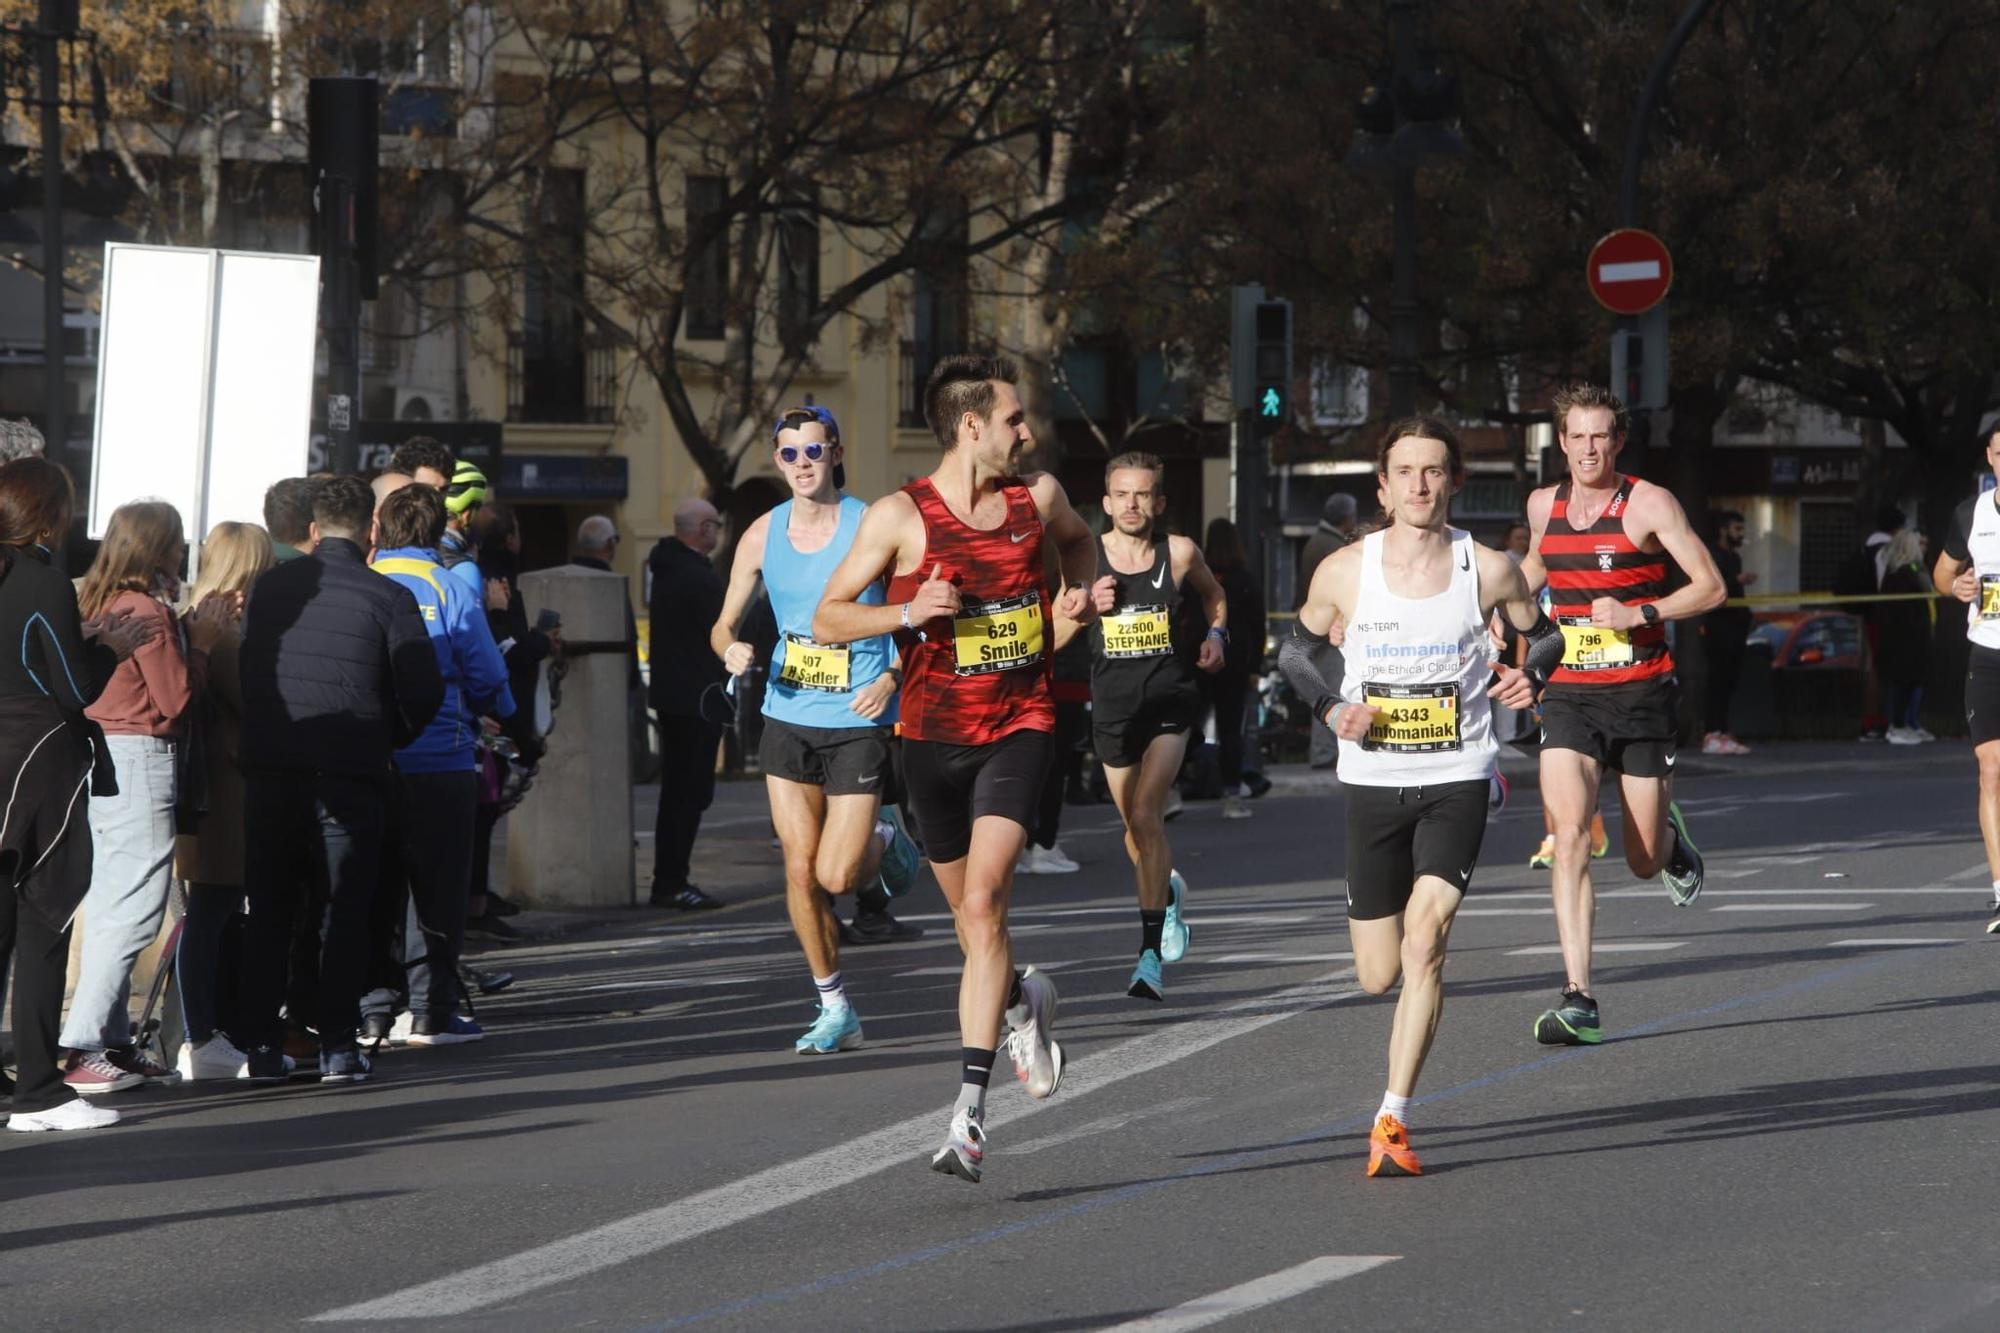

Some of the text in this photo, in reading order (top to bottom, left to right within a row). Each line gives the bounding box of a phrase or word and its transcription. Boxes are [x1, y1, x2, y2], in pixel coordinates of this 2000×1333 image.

[1608, 492, 1624, 516] soar
[988, 622, 1017, 639] 629
[1118, 622, 1154, 634] 22500
[1358, 622, 1400, 632] NS-TEAM
[1107, 633, 1168, 649] STEPHANE
[1579, 634, 1602, 646] 796
[980, 640, 1028, 661] Smile
[1576, 648, 1605, 662] Carl
[787, 665, 840, 685] H Sadler
[1388, 663, 1425, 675] Ethical
[1428, 662, 1459, 673] Cloud
[1391, 708, 1429, 722] 4343
[1370, 723, 1454, 739] Infomaniak
